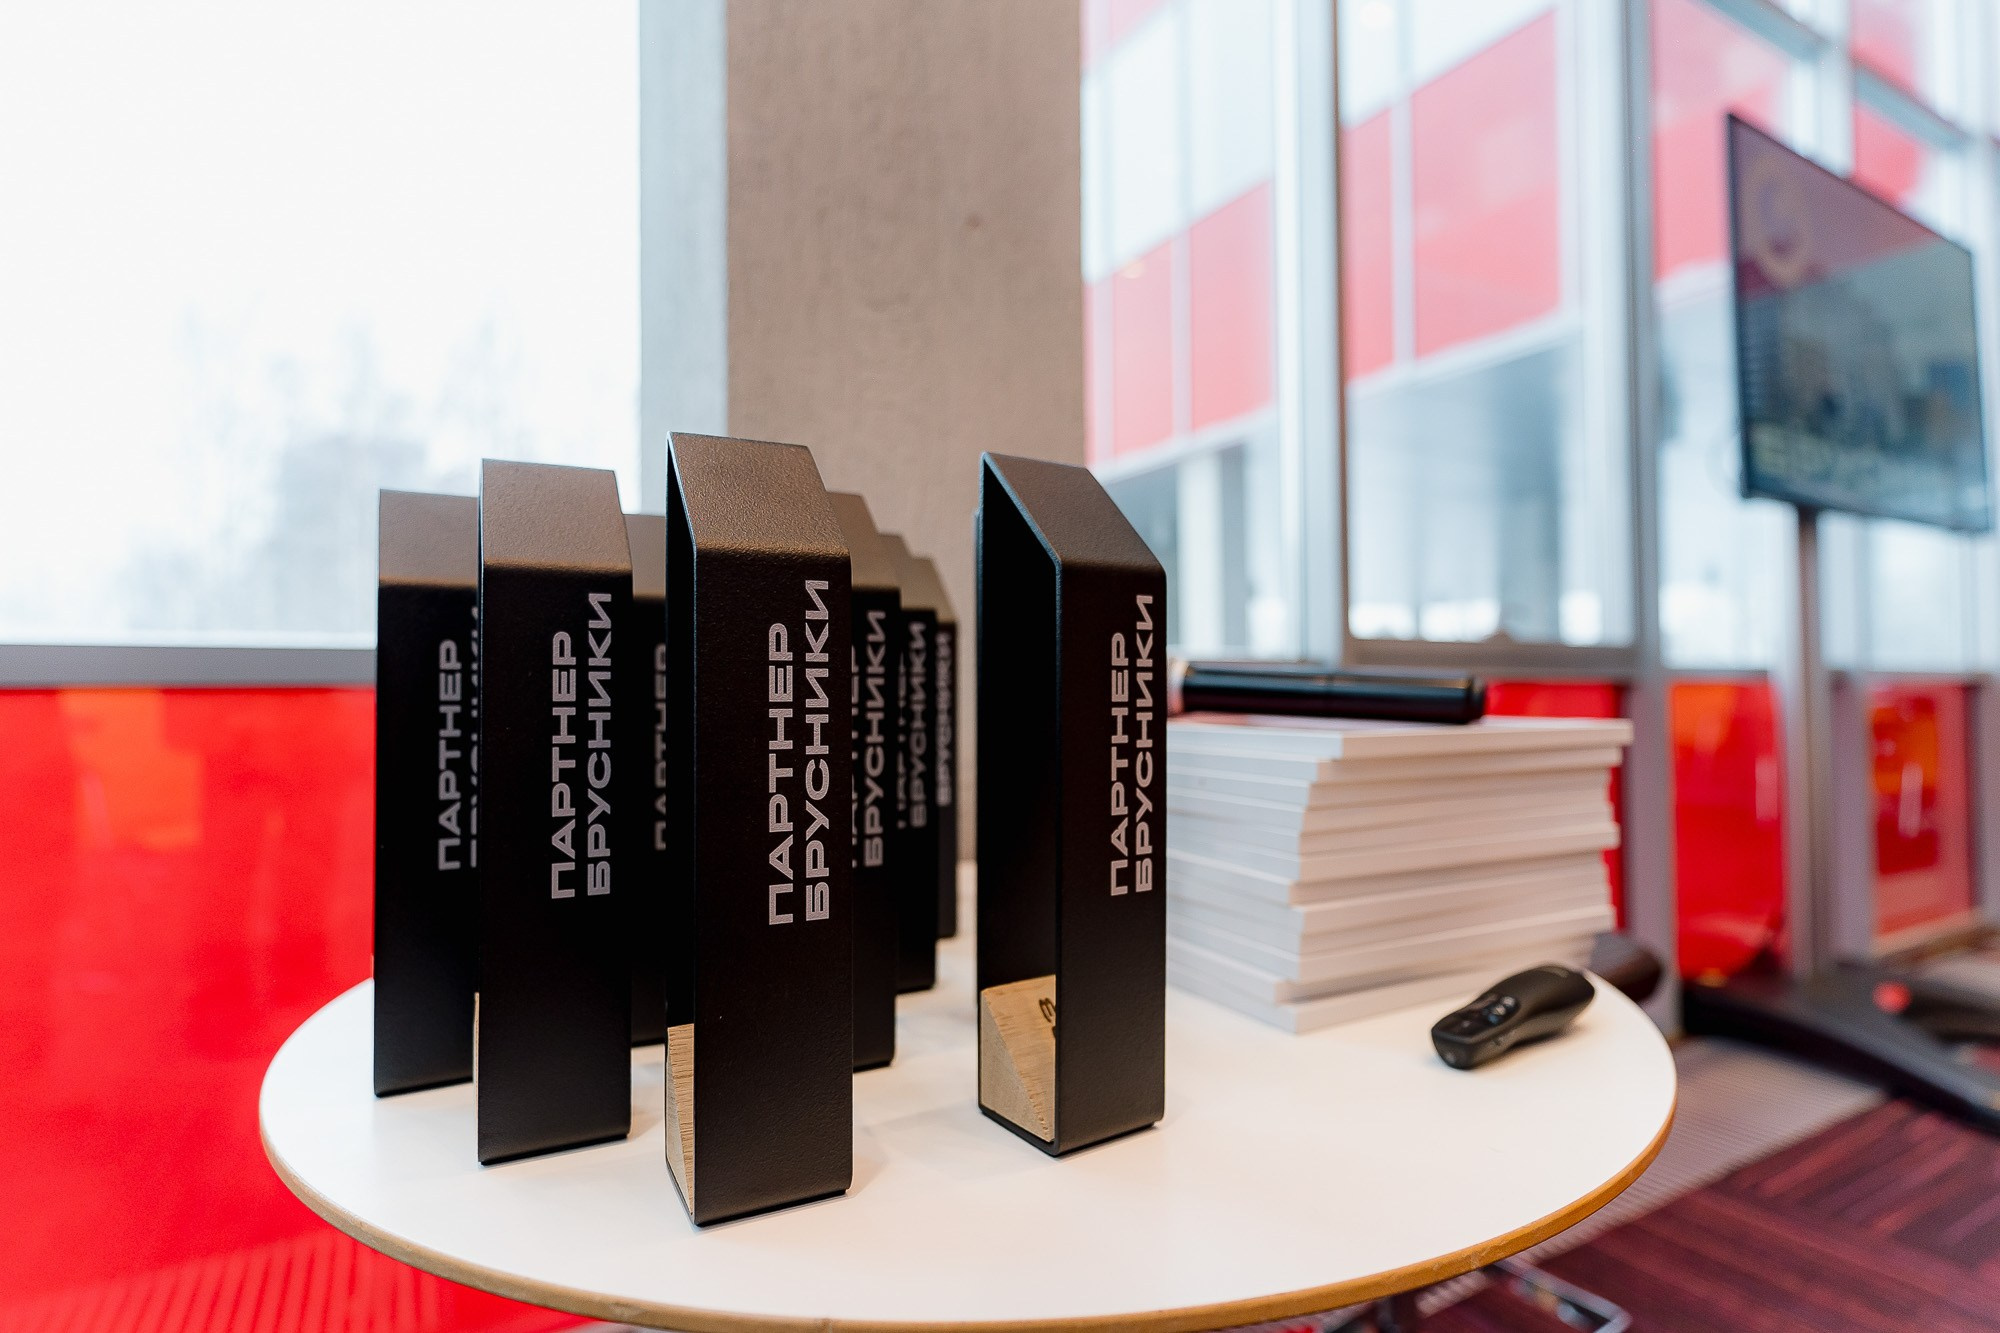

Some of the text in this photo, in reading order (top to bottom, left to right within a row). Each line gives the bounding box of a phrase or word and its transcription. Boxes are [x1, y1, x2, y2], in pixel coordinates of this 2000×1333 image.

[438, 639, 462, 870] ПАРТНЕР
[551, 631, 577, 900] ПАРТНЕР
[587, 592, 612, 896] БРУСНИКИ
[768, 622, 794, 926] ПАРТНЕР
[805, 579, 830, 922] БРУСНИКИ
[864, 610, 887, 868] БРУСНИКИ
[1110, 632, 1129, 897] ПАРТНЕР
[1135, 594, 1154, 894] БРУСНИКИ
